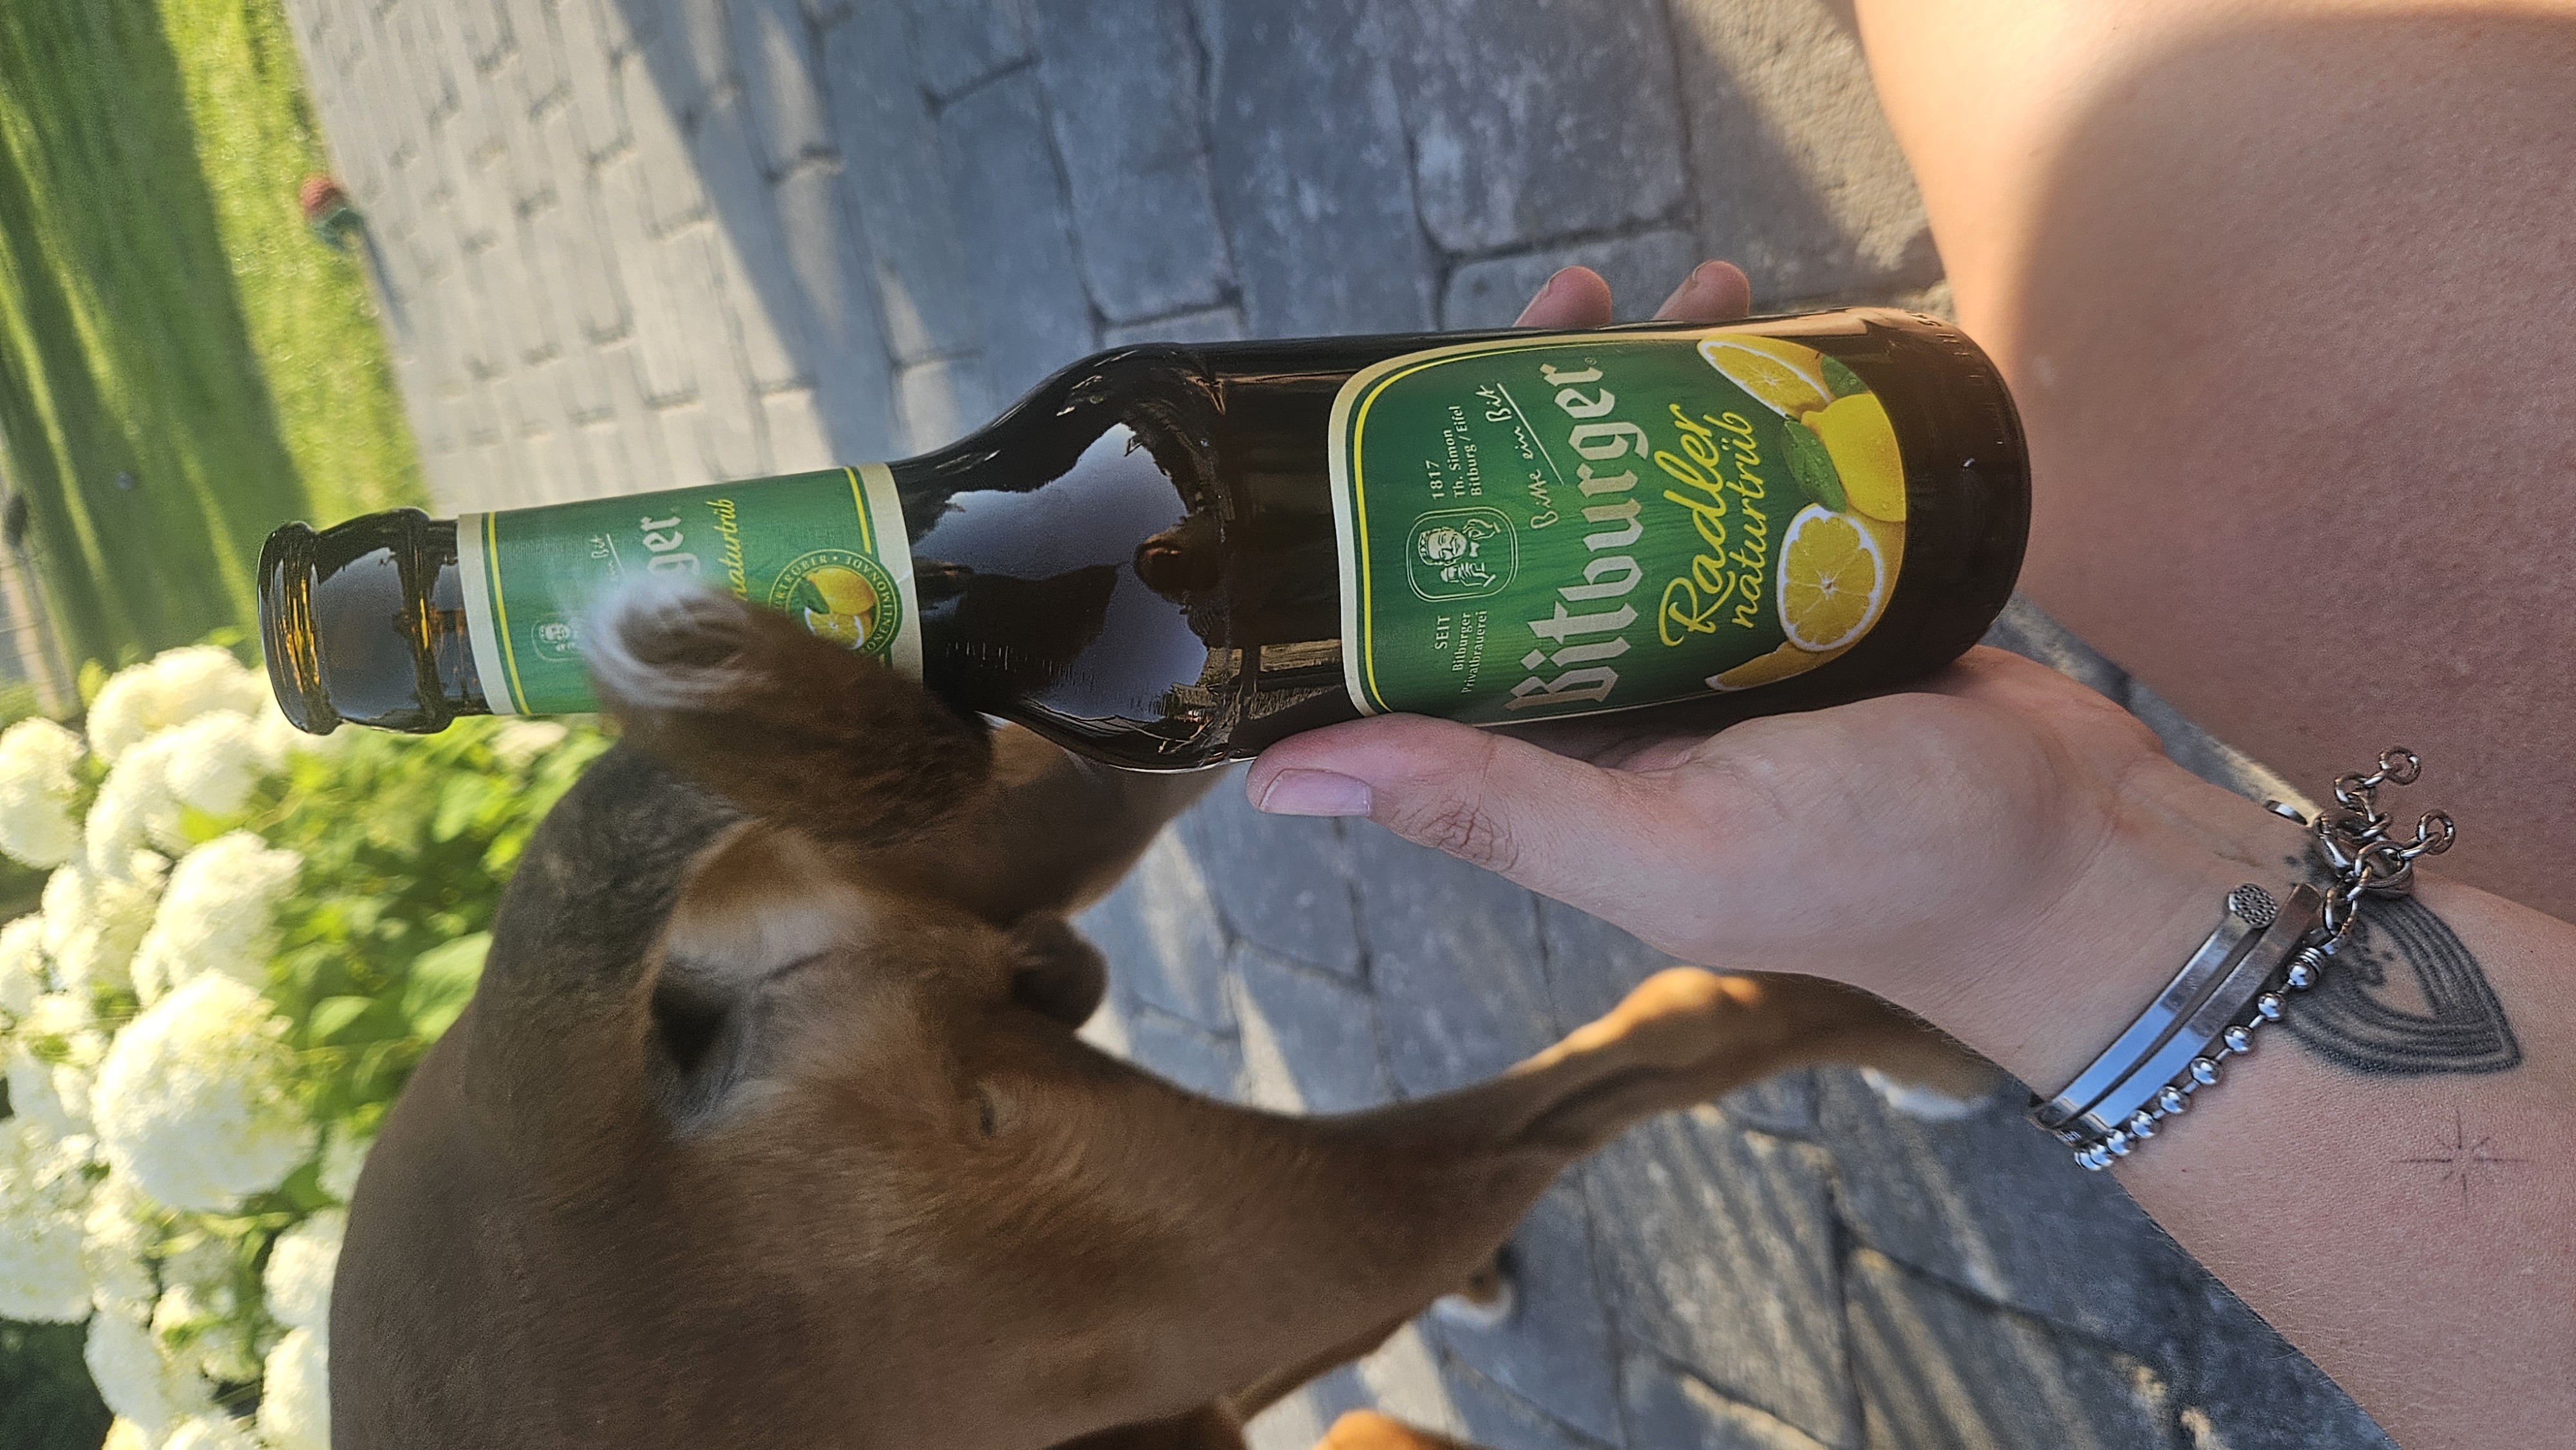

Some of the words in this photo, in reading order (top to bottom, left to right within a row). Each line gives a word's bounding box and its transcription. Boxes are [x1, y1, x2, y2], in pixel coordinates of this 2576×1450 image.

[1448, 406, 1468, 433] Eifel
[1475, 384, 1513, 422] Bit
[1443, 429, 1461, 471] Simon
[1513, 426, 1534, 460] ein
[1425, 460, 1445, 500] 1817
[1452, 475, 1466, 499] Th.
[1464, 444, 1482, 496] Bitburg
[1527, 469, 1559, 529] Bitte
[1658, 403, 1736, 646] Radler
[1703, 411, 1768, 628] naturtrüb
[1503, 362, 1649, 710] Bitburger
[844, 555, 893, 651] ONENLIMONADE
[1434, 615, 1450, 650] SEIT
[1452, 612, 1473, 672] Bitburger
[1461, 610, 1487, 693] Privatbrauerei
